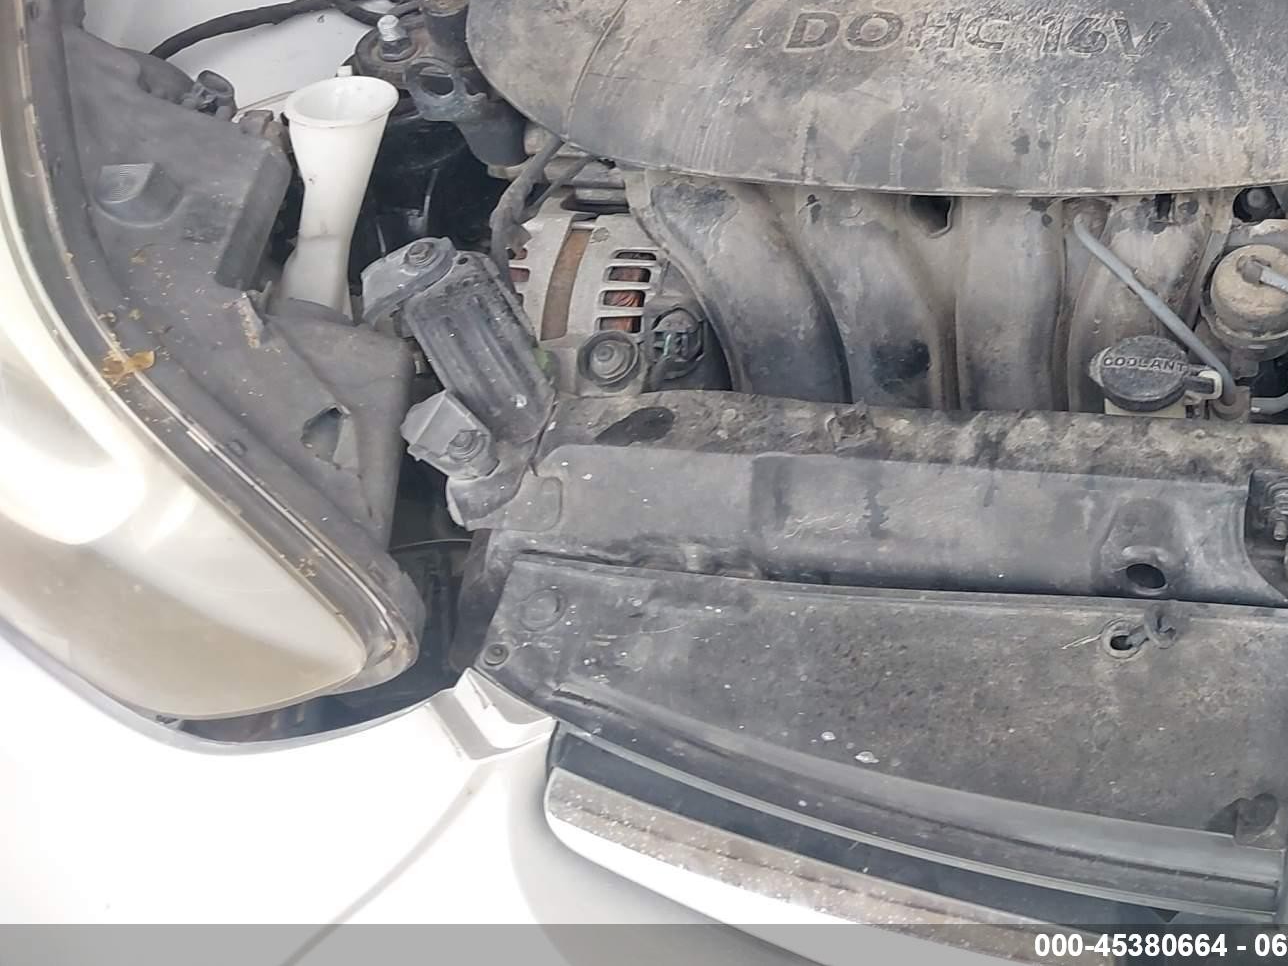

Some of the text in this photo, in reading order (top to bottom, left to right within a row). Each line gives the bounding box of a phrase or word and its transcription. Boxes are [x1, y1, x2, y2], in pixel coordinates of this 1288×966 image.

[783, 10, 1173, 57] DOHC 16V
[1103, 356, 1188, 373] COOLANT
